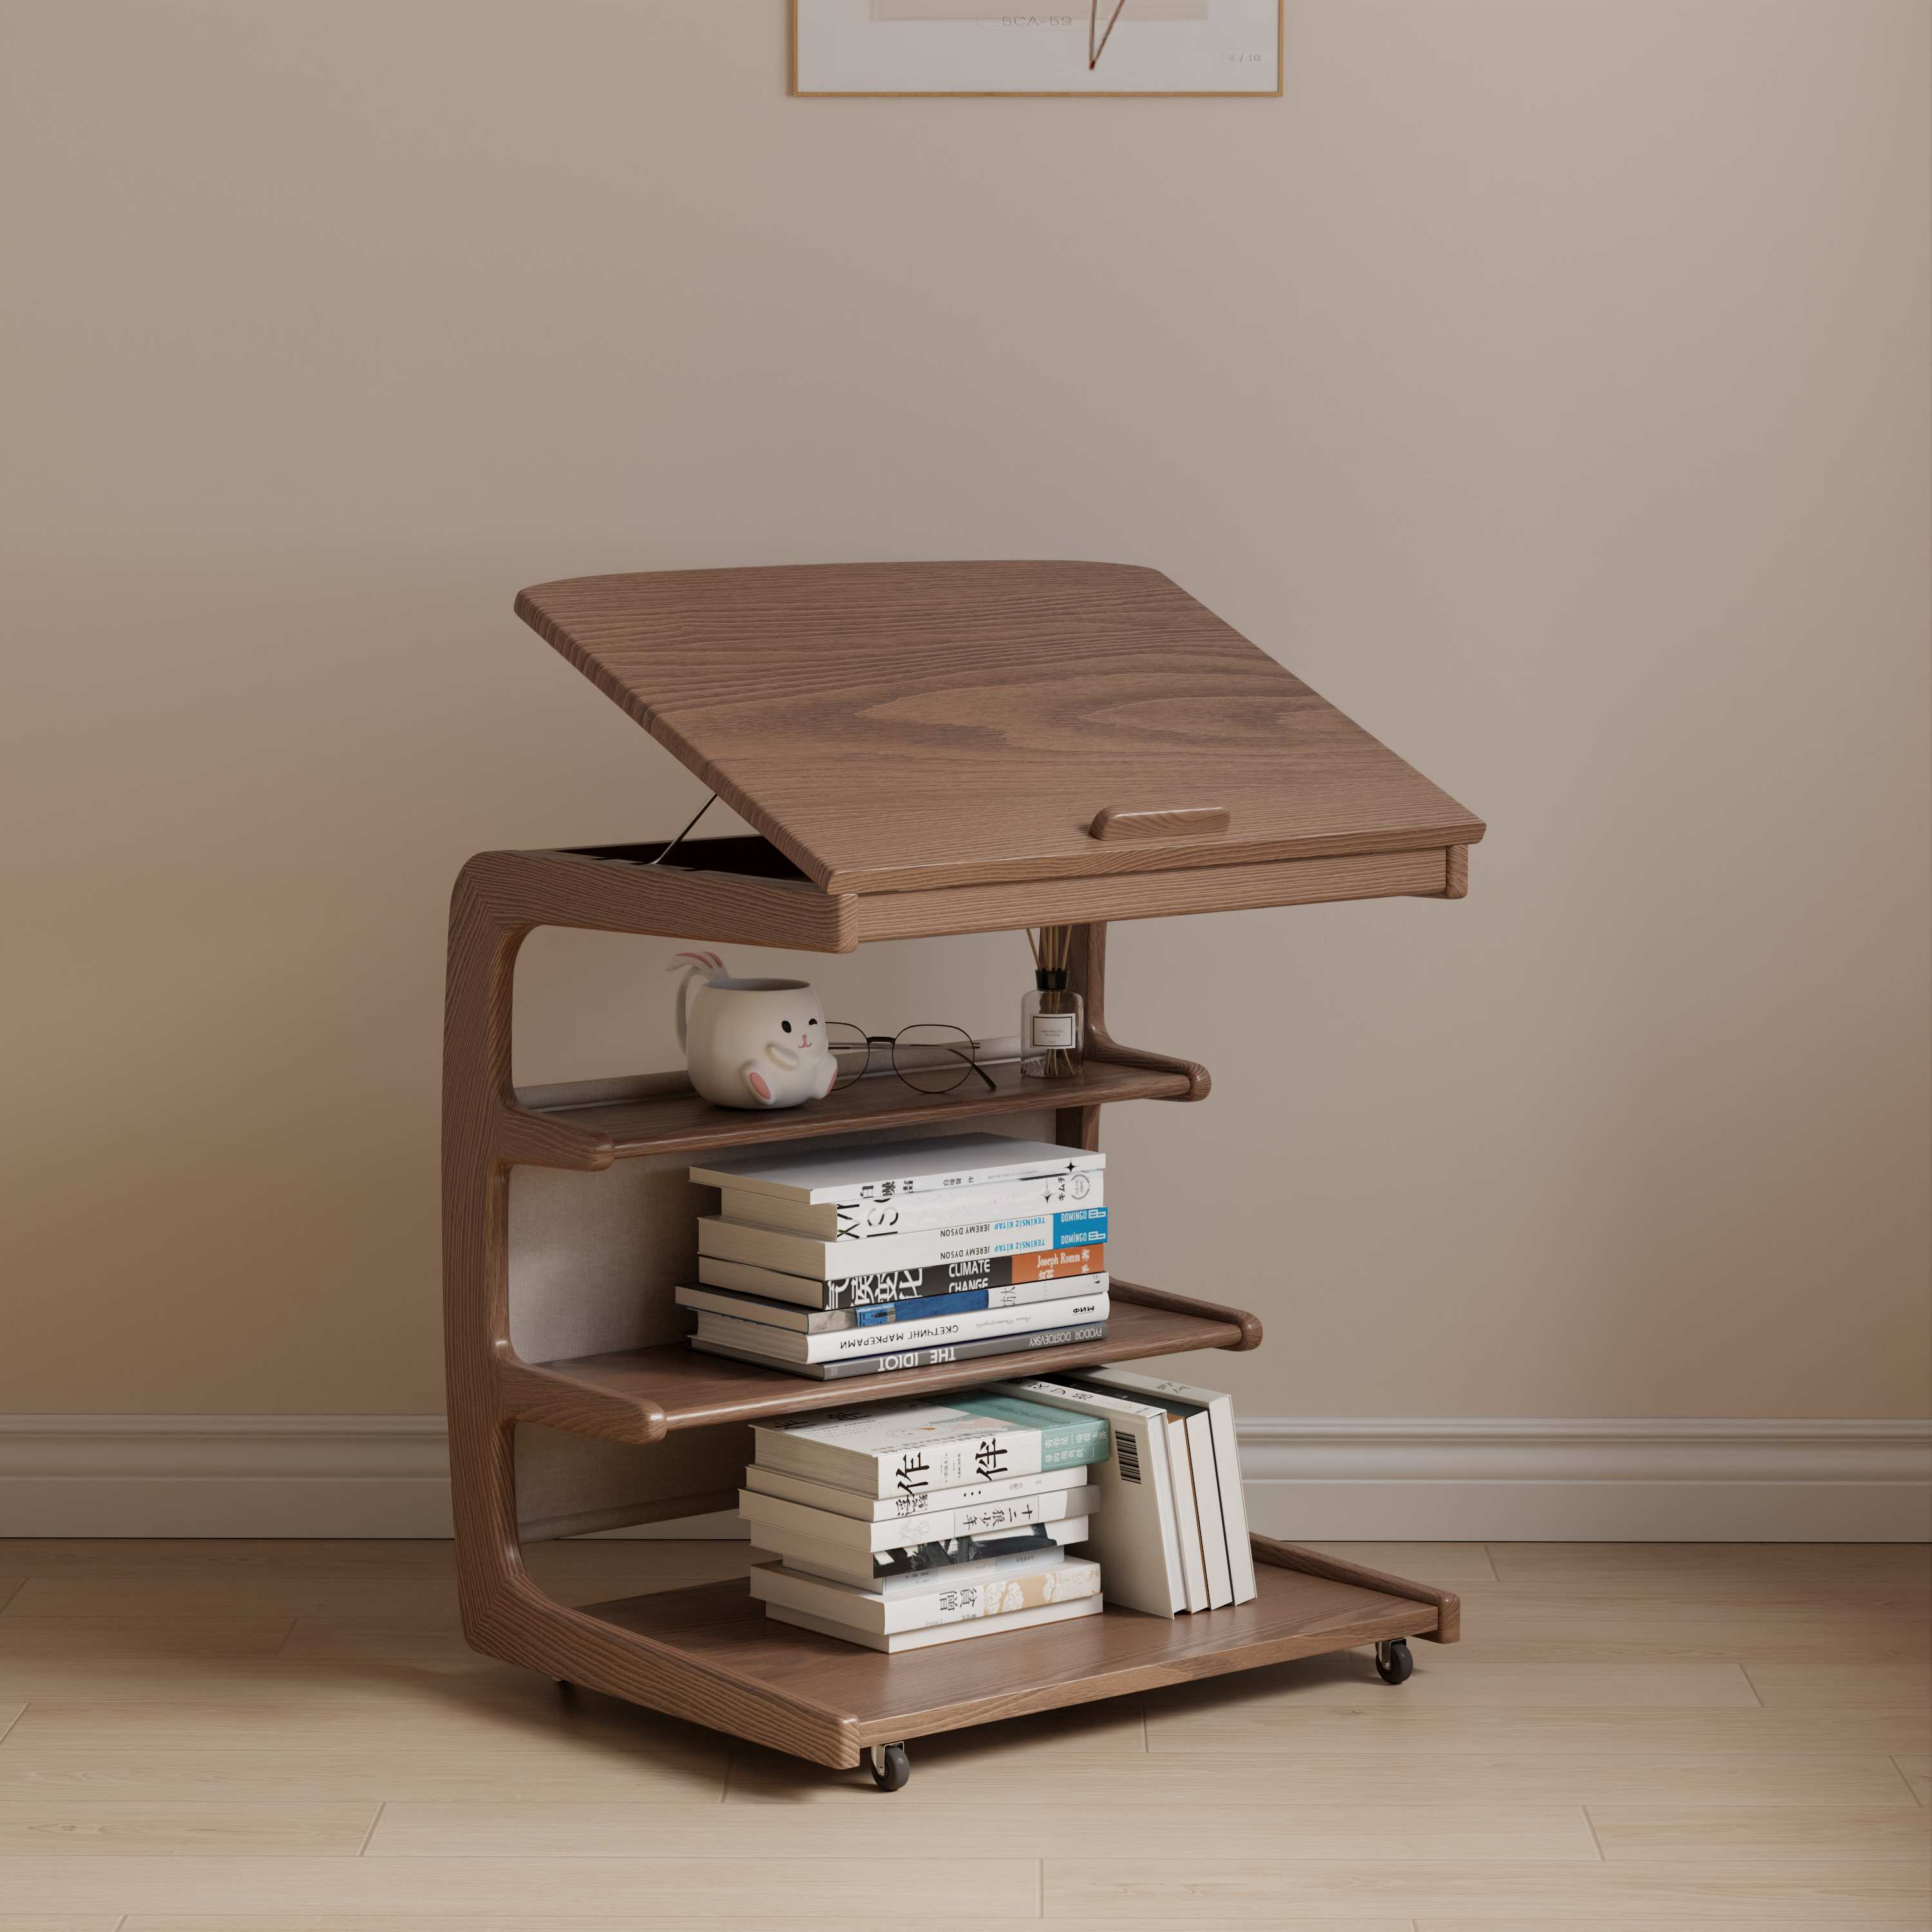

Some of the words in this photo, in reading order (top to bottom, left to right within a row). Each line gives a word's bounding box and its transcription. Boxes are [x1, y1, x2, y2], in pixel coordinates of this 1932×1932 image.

[940, 1229, 963, 1238] DYSON
[965, 1224, 990, 1235] JEREMY
[940, 1251, 963, 1260] DYSON
[965, 1245, 990, 1256] JEREMY
[1037, 1253, 1059, 1268] Joseph
[1061, 1252, 1081, 1264] Romm
[949, 1259, 990, 1278] CLIMATE
[949, 1278, 989, 1294] CHANGE
[907, 1325, 959, 1340] СКЕТЧИНГ
[1028, 1332, 1071, 1347] DOSTOEVSKY
[1075, 1327, 1102, 1340] FYODOR
[840, 1332, 904, 1349] МАРКЕРАМИ
[877, 1352, 919, 1372] IDIOT
[929, 1347, 956, 1364] THE
[962, 1504, 1034, 1531] 十二狼少年
